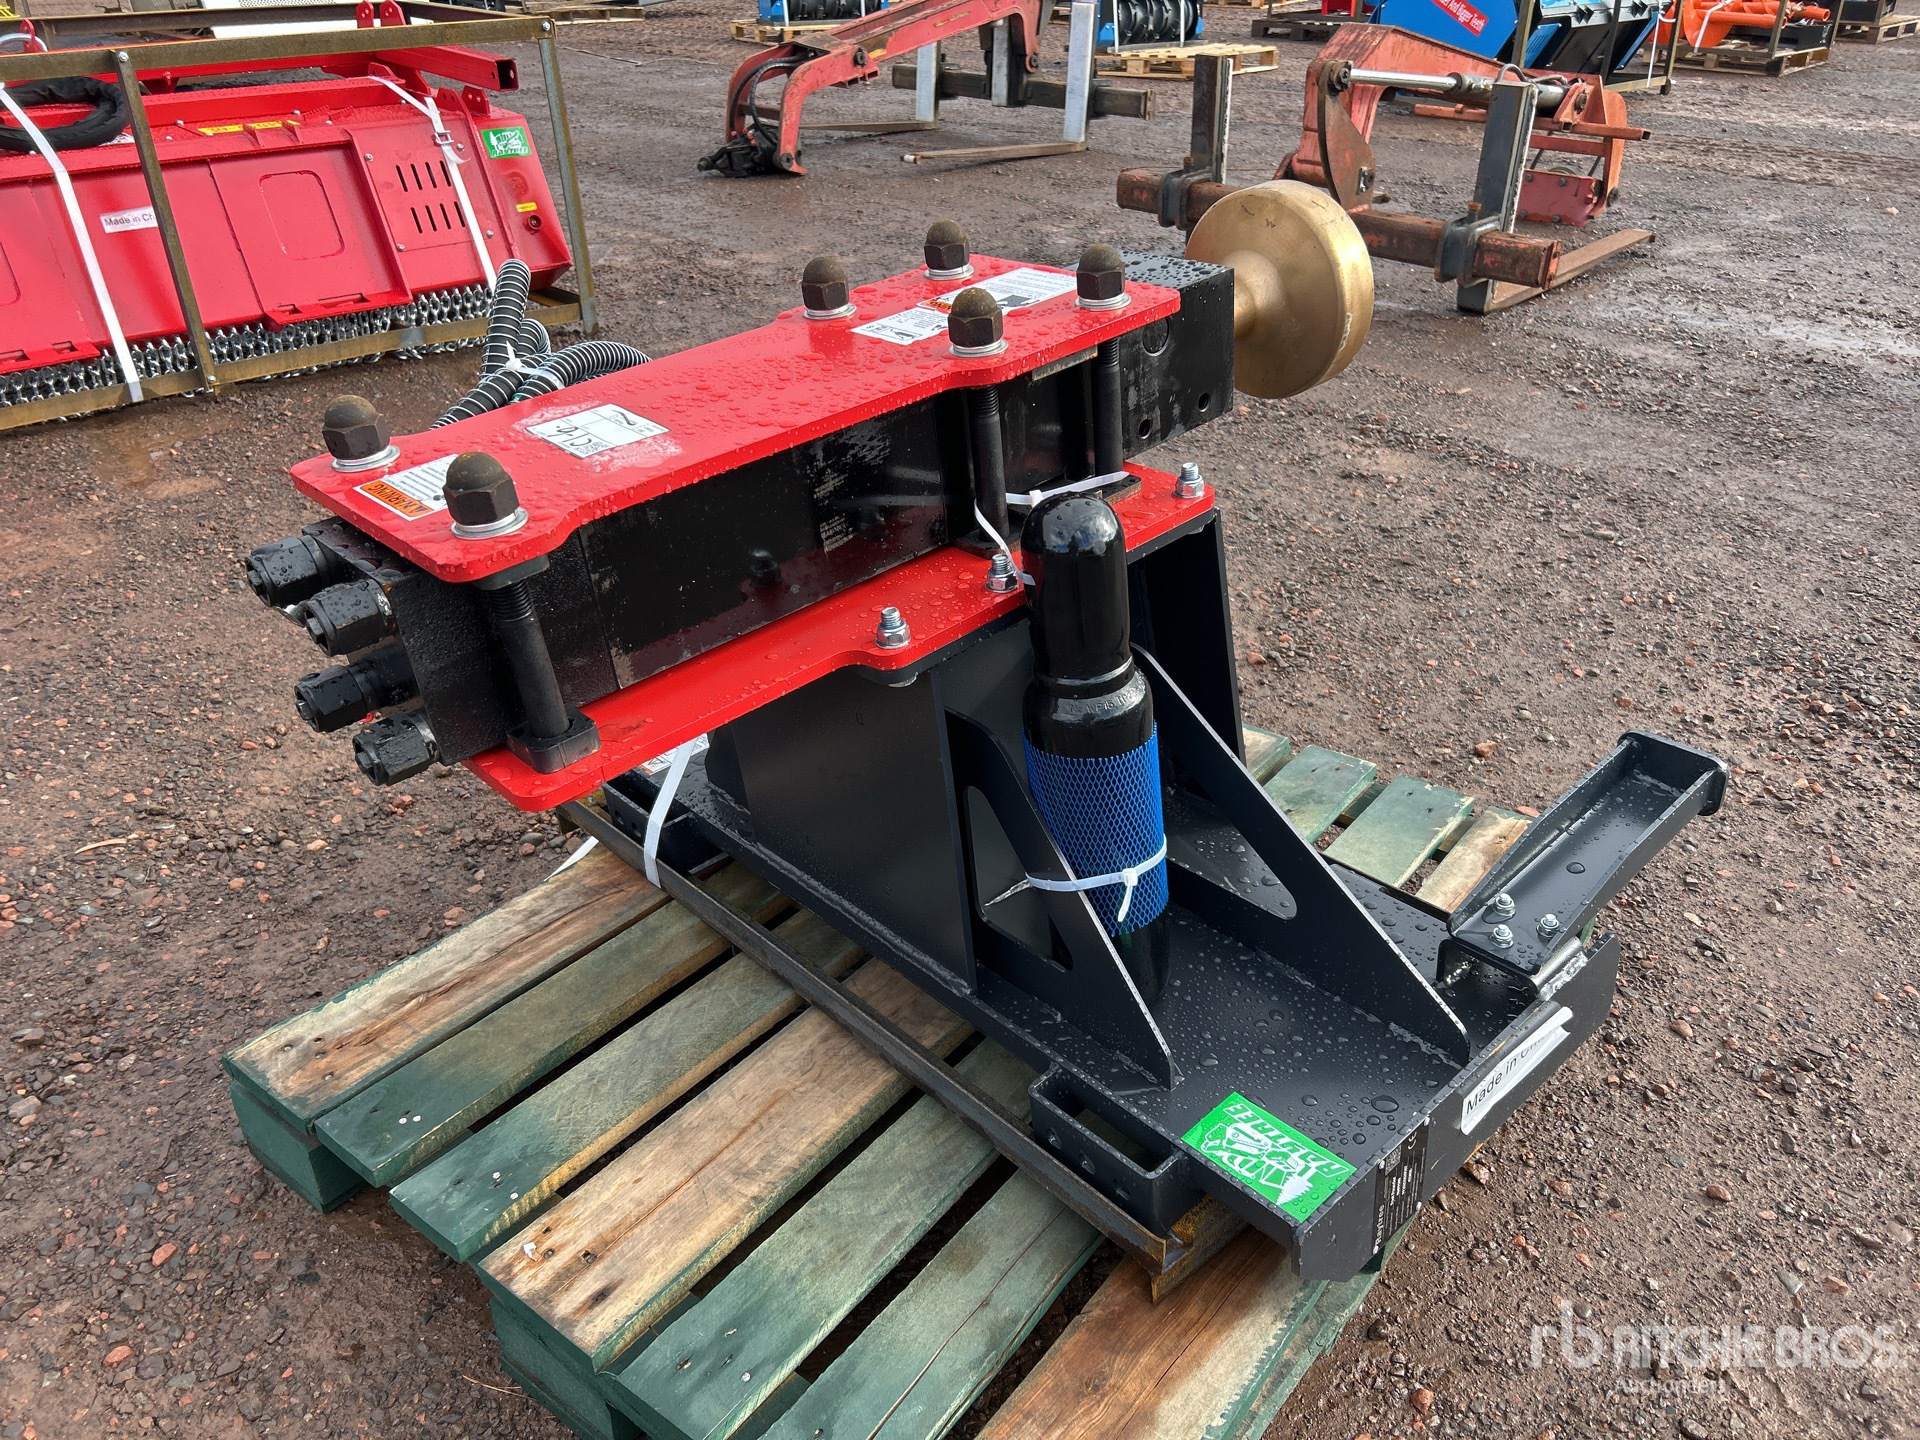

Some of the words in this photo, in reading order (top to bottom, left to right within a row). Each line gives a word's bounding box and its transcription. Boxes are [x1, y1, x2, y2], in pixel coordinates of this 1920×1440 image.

[104, 216, 131, 226] Made
[367, 483, 417, 510] WARNING
[1466, 1073, 1503, 1115] Made
[1505, 1057, 1517, 1076] in
[1375, 1204, 1385, 1247] Raytree
